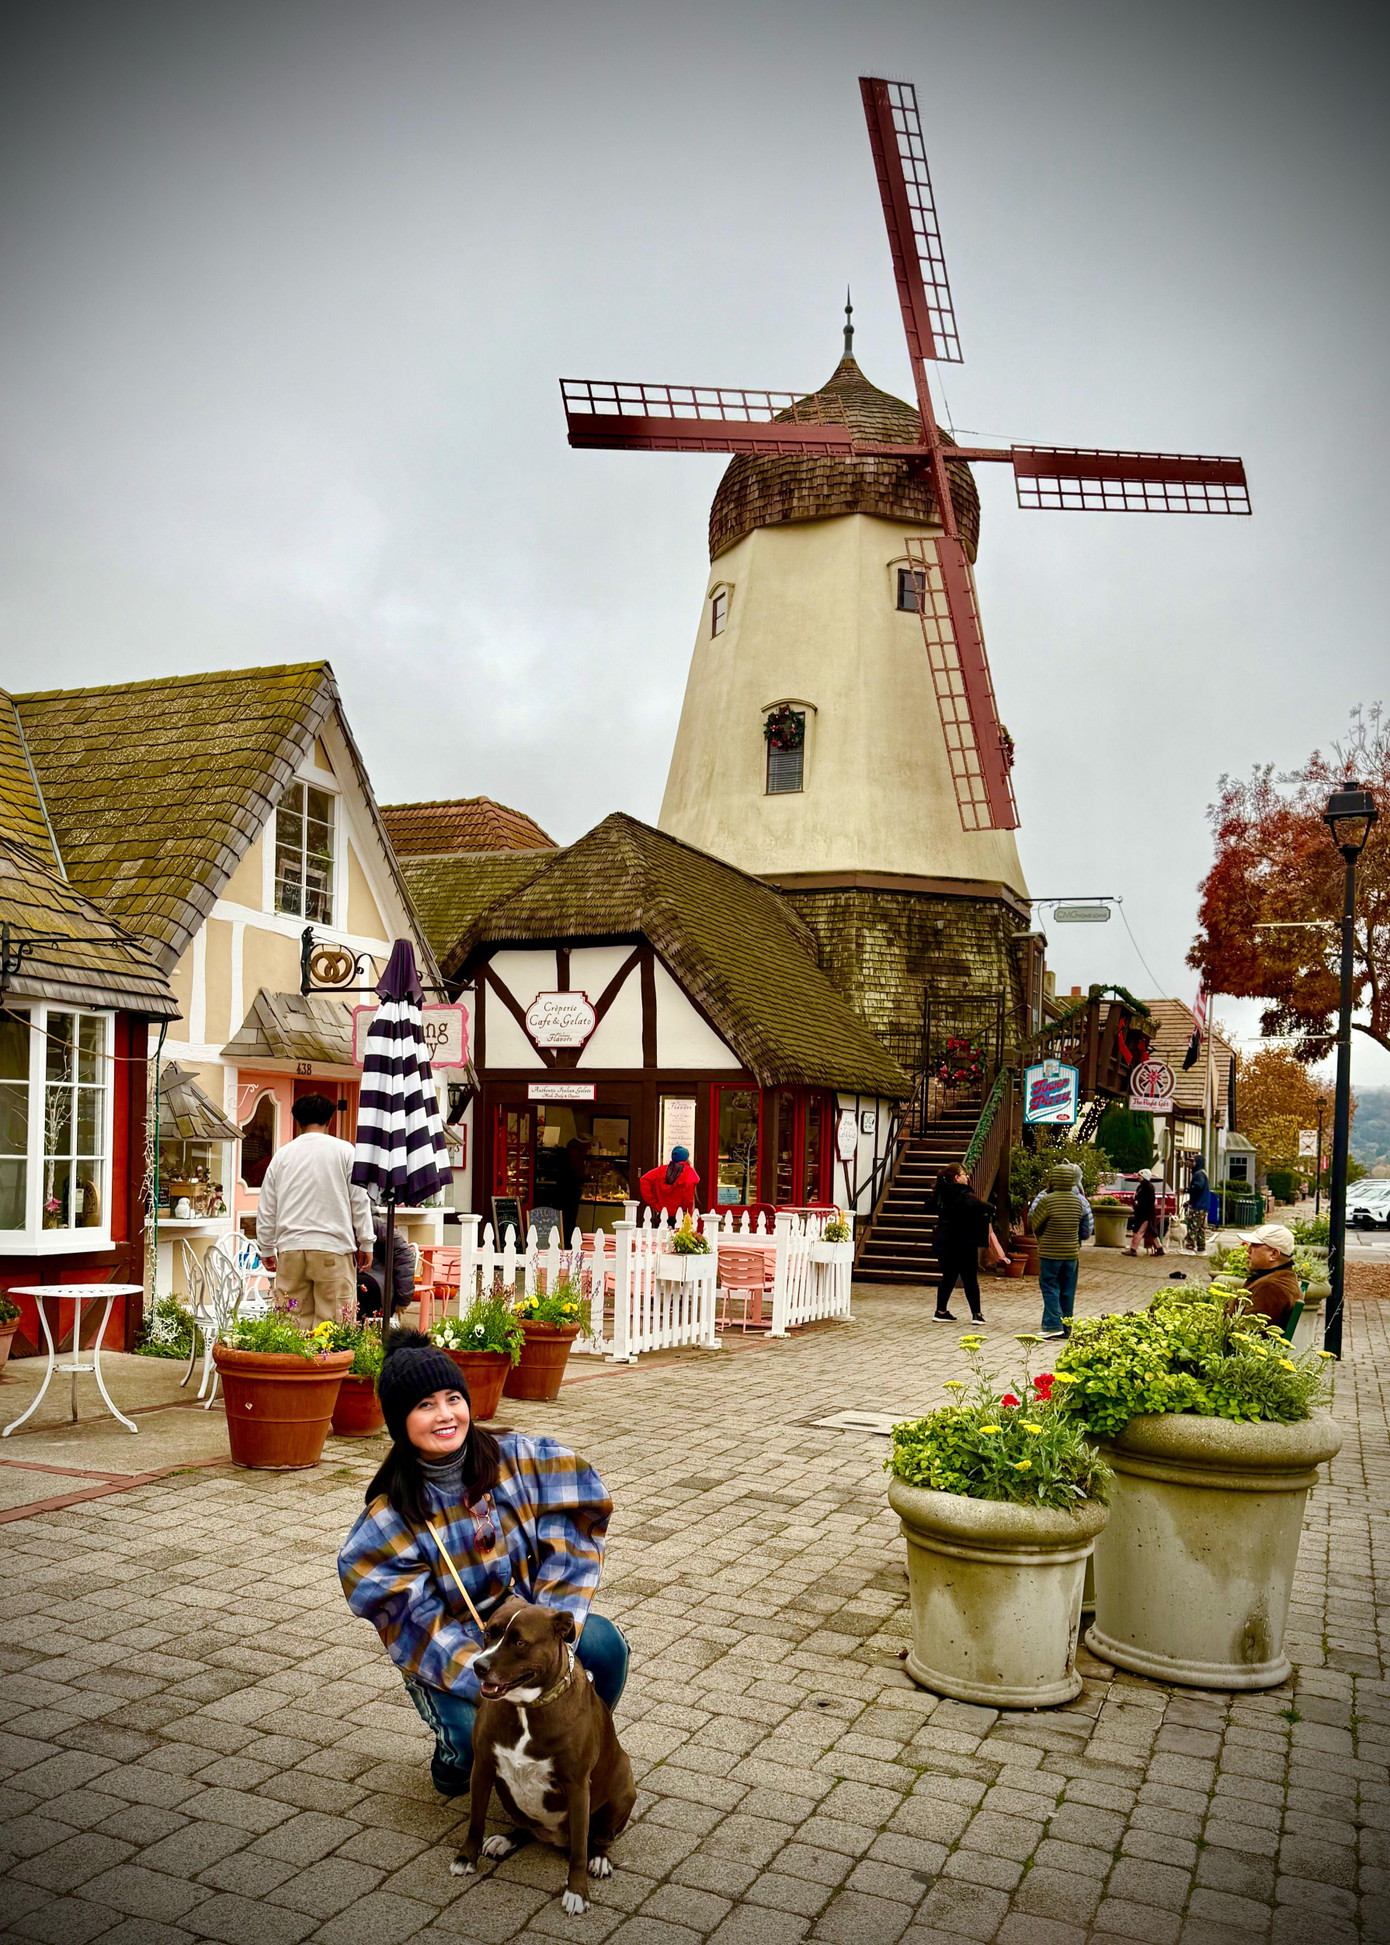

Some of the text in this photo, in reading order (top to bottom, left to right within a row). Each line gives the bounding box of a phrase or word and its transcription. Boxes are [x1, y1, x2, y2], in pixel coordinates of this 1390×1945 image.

[530, 1012, 592, 1028] Cafe & Gelato
[296, 1062, 312, 1075] 438
